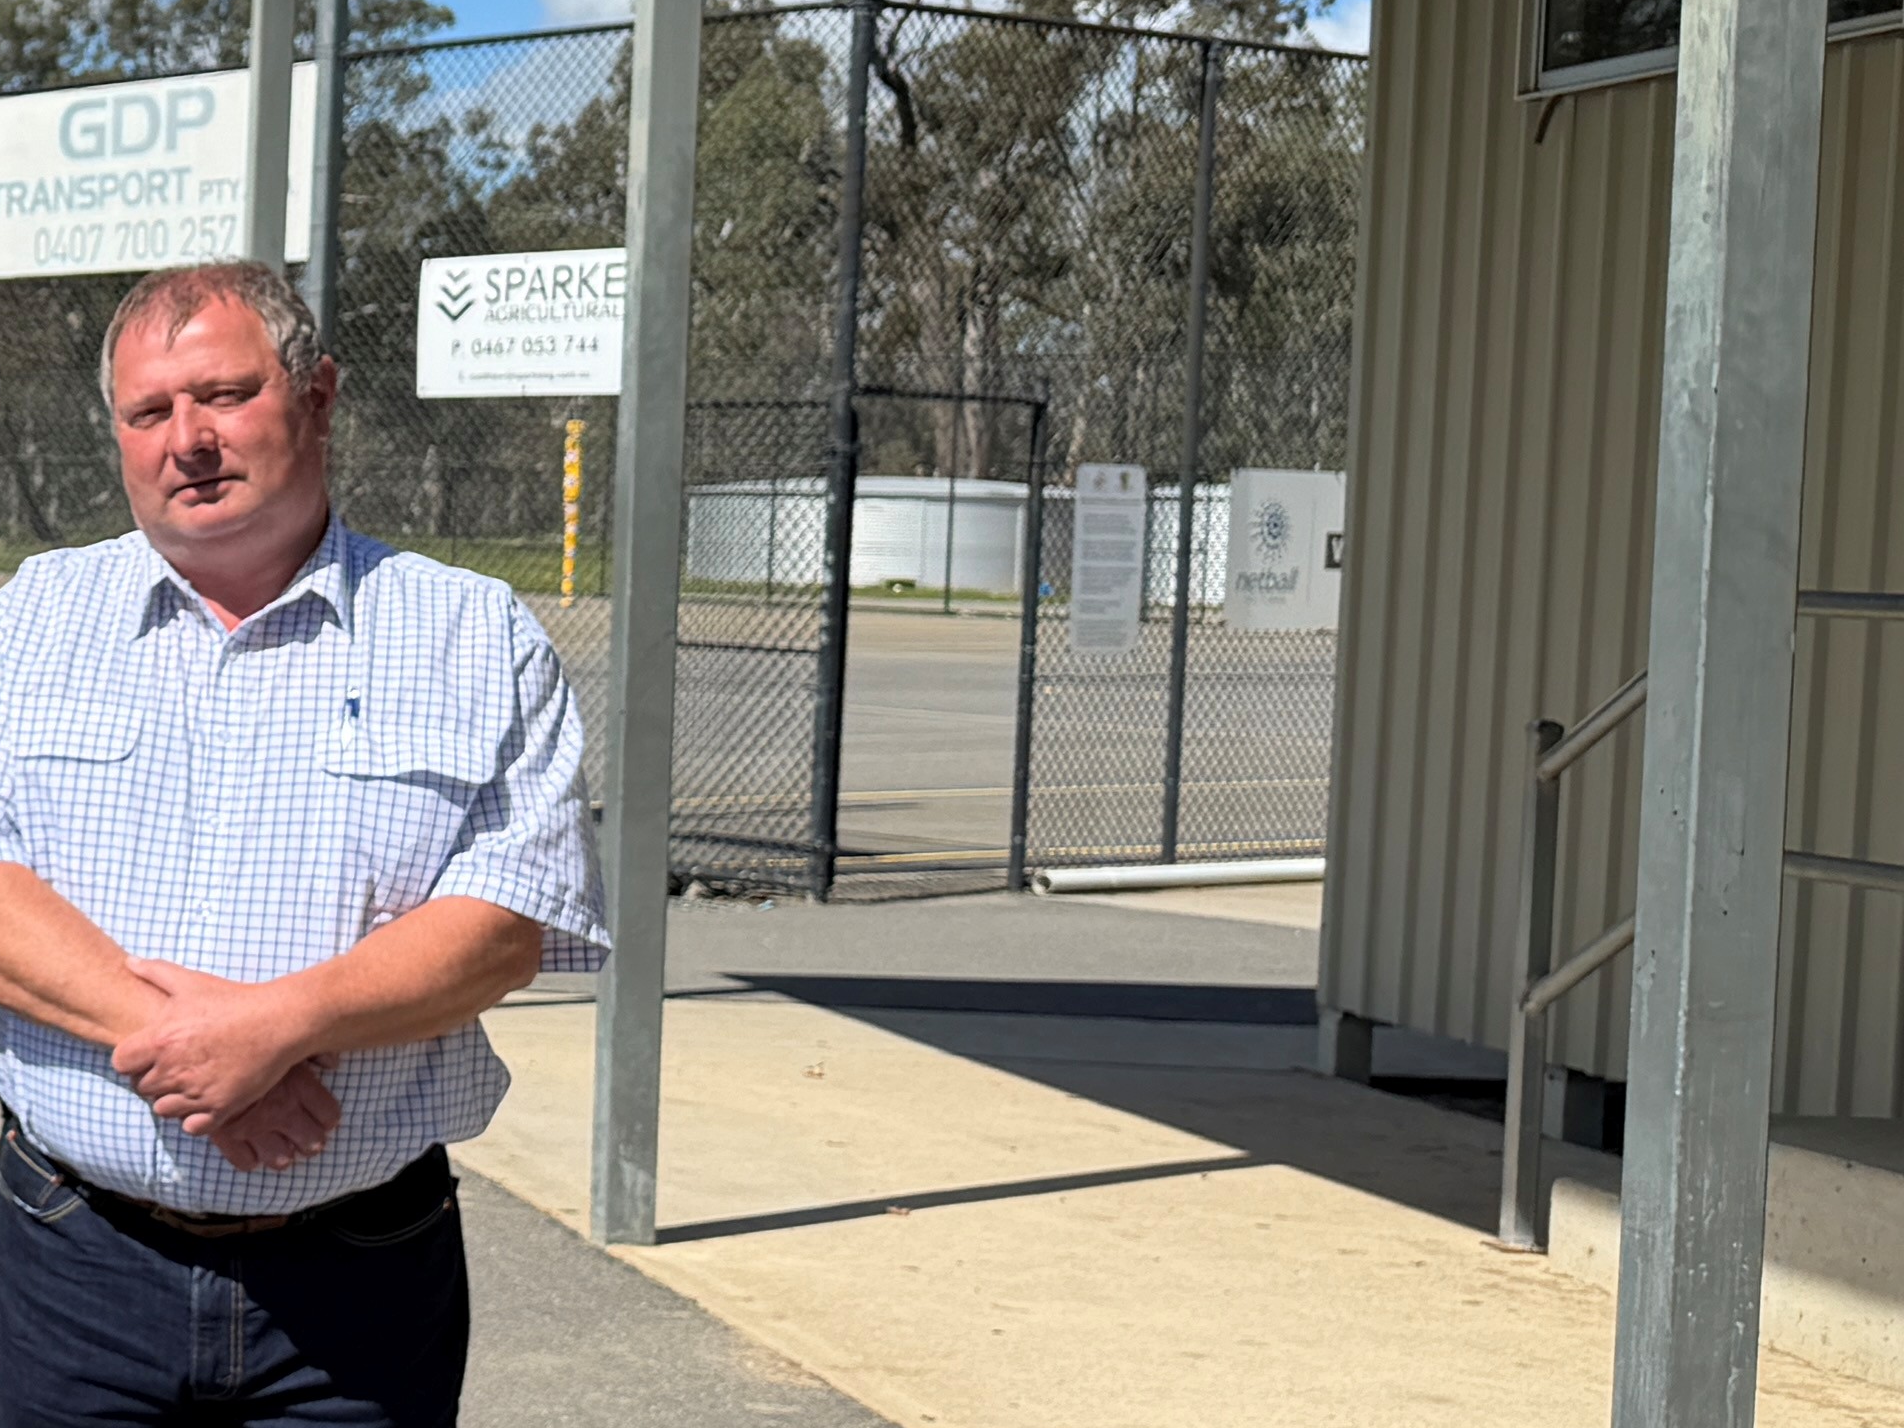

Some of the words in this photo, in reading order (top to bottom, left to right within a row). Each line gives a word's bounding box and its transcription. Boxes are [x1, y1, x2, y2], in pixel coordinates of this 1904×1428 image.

[59, 86, 215, 160] GDP
[34, 224, 103, 266] 0407
[114, 219, 169, 260] 700
[178, 214, 237, 257] 257
[470, 339, 516, 356] 0467
